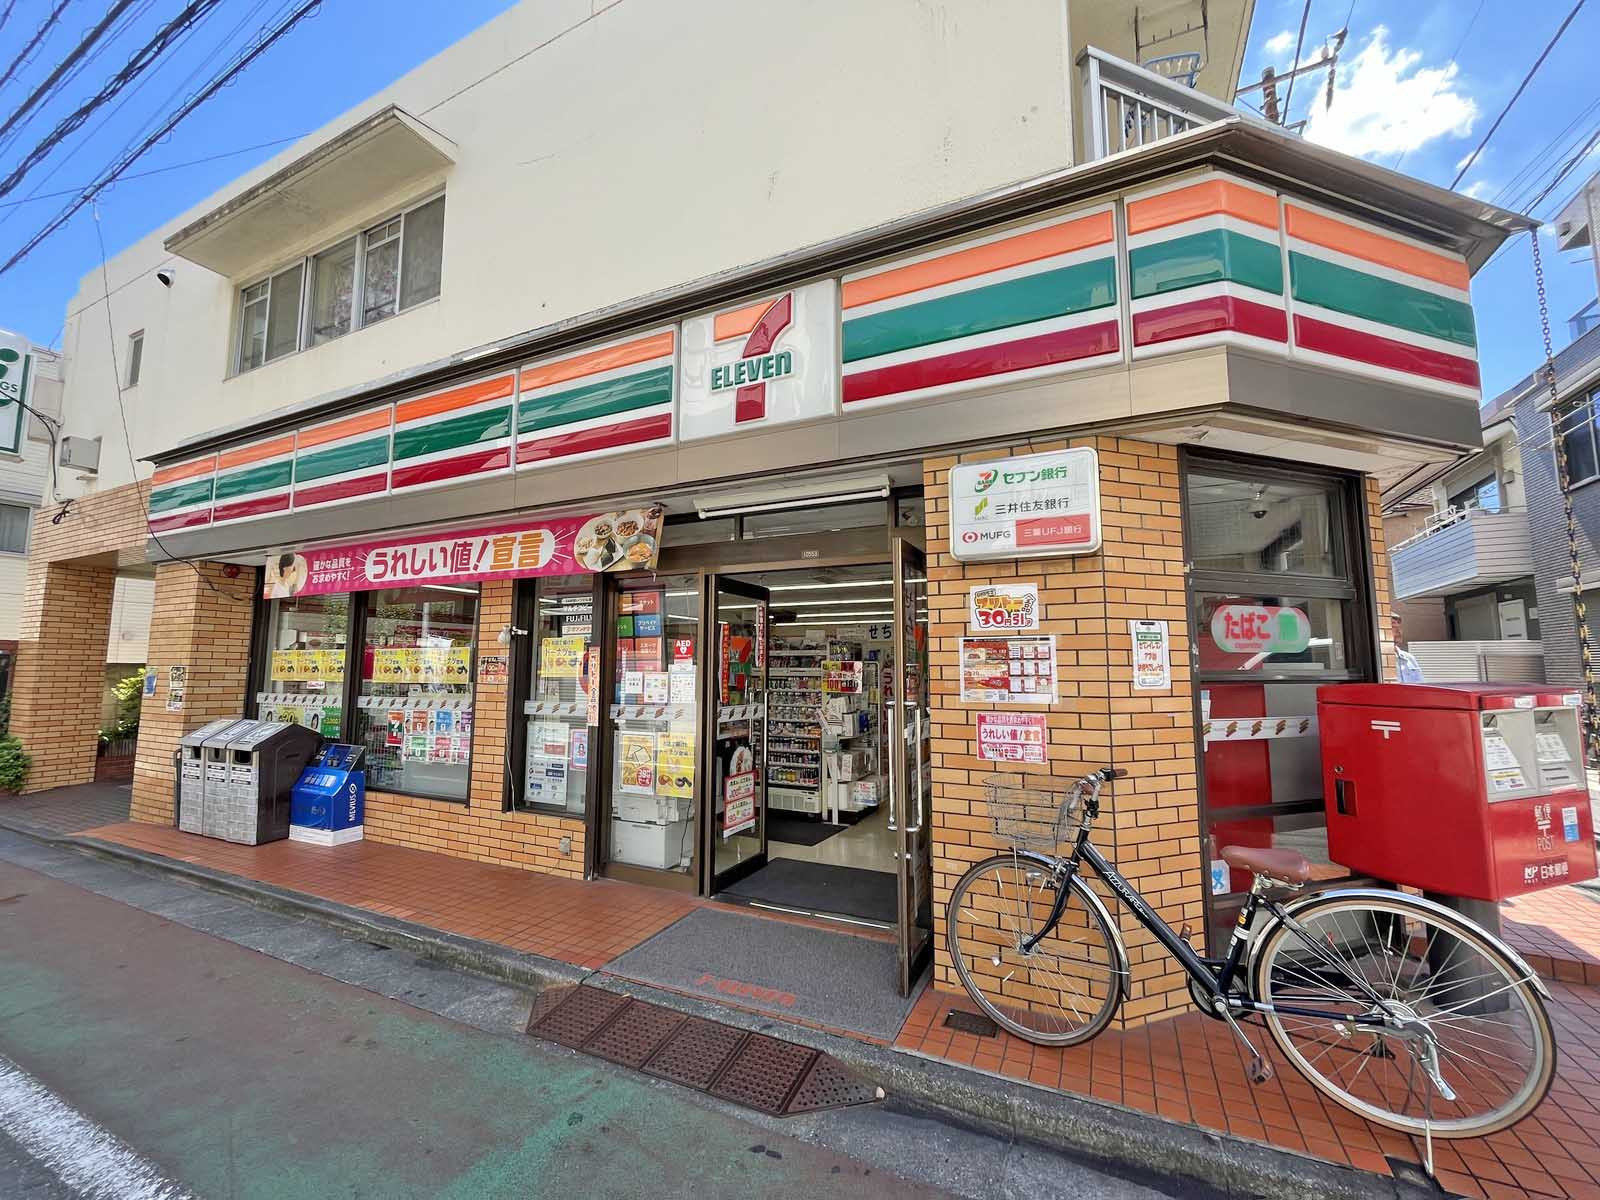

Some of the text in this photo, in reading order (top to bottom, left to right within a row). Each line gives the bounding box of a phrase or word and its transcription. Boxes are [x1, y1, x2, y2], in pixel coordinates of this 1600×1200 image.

[1003, 466, 1067, 485] セブン銀行
[995, 497, 1069, 515] 三井住友銀行
[980, 531, 1011, 541] MUFG
[1024, 526, 1082, 538] 三菱UFJ銀行
[1224, 612, 1271, 640] たばこ
[1541, 862, 1569, 879] 日本郵便
